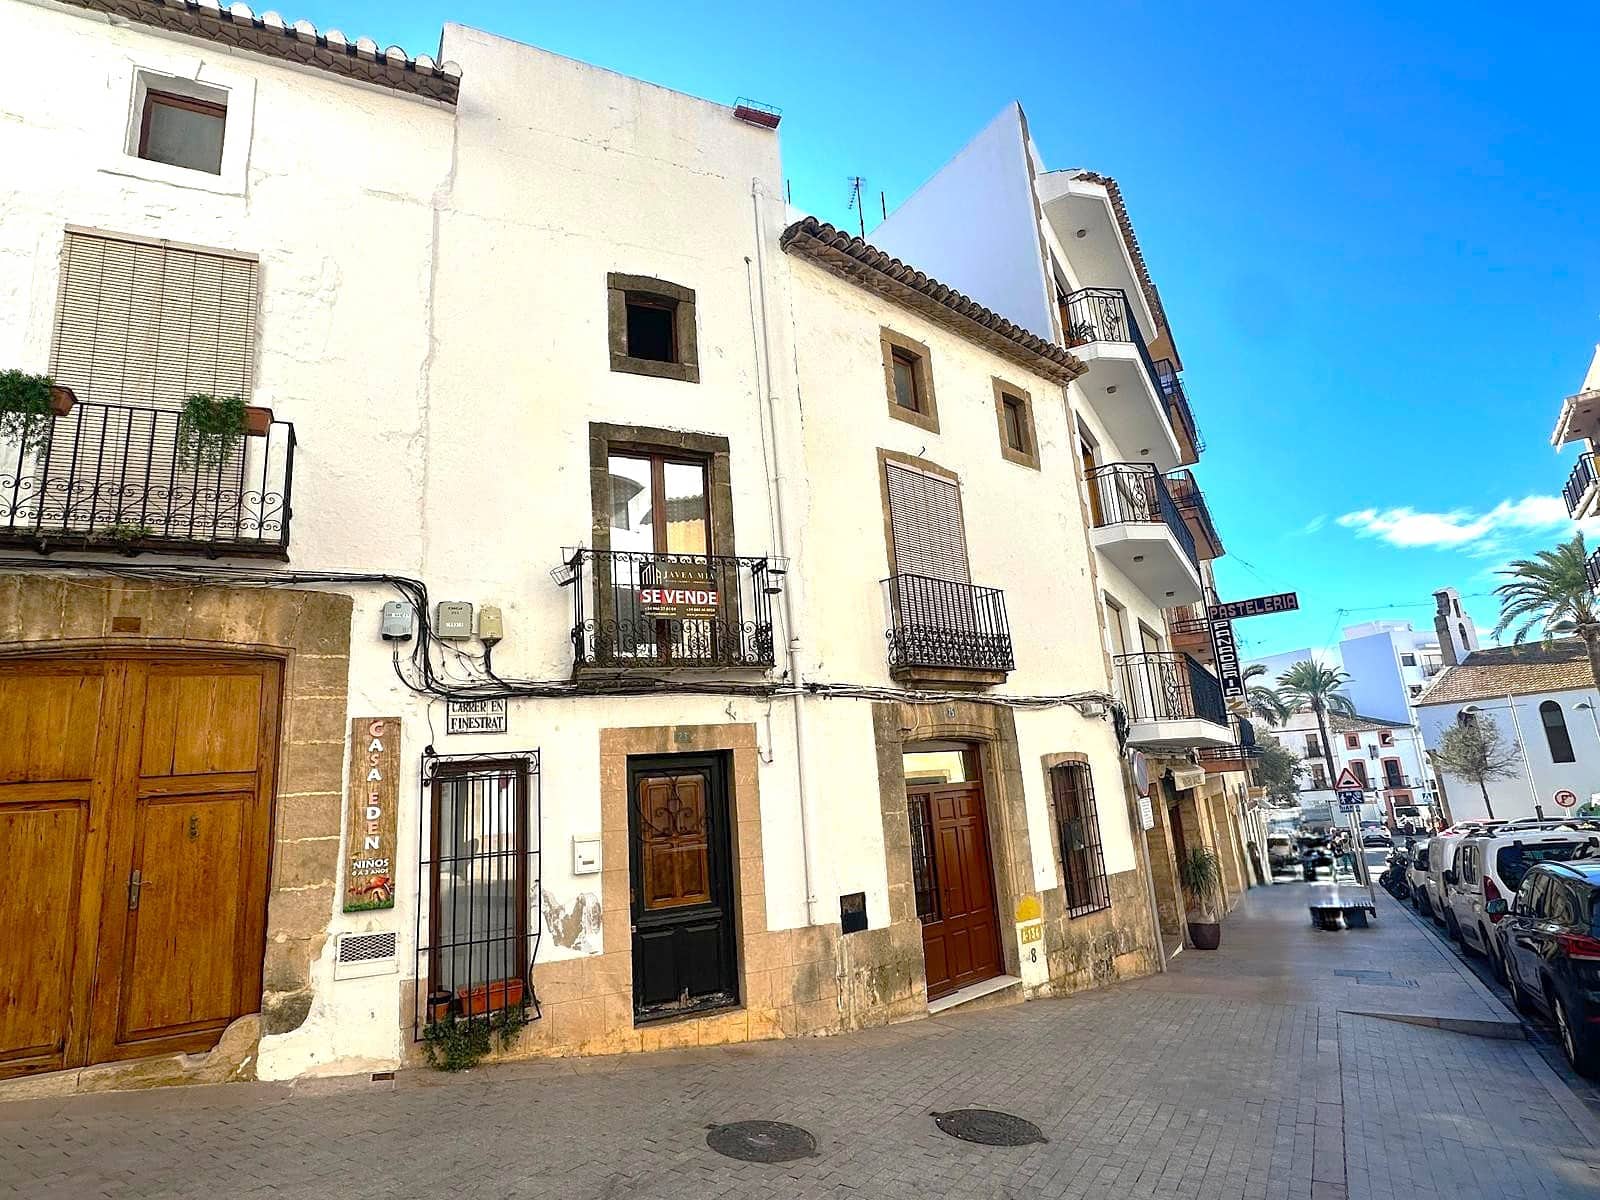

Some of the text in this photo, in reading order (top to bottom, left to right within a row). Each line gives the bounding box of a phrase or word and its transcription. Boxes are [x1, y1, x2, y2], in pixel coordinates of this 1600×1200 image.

[641, 589, 718, 605] SE VENDE
[1209, 594, 1297, 620] PASTELERIA
[1213, 620, 1241, 696] PANADERIA
[451, 700, 504, 713] CARRER EN
[450, 716, 504, 729] FINESTRAT
[367, 720, 385, 782] CASA
[364, 792, 382, 850] EDEN
[352, 857, 390, 869] NIÑOS
